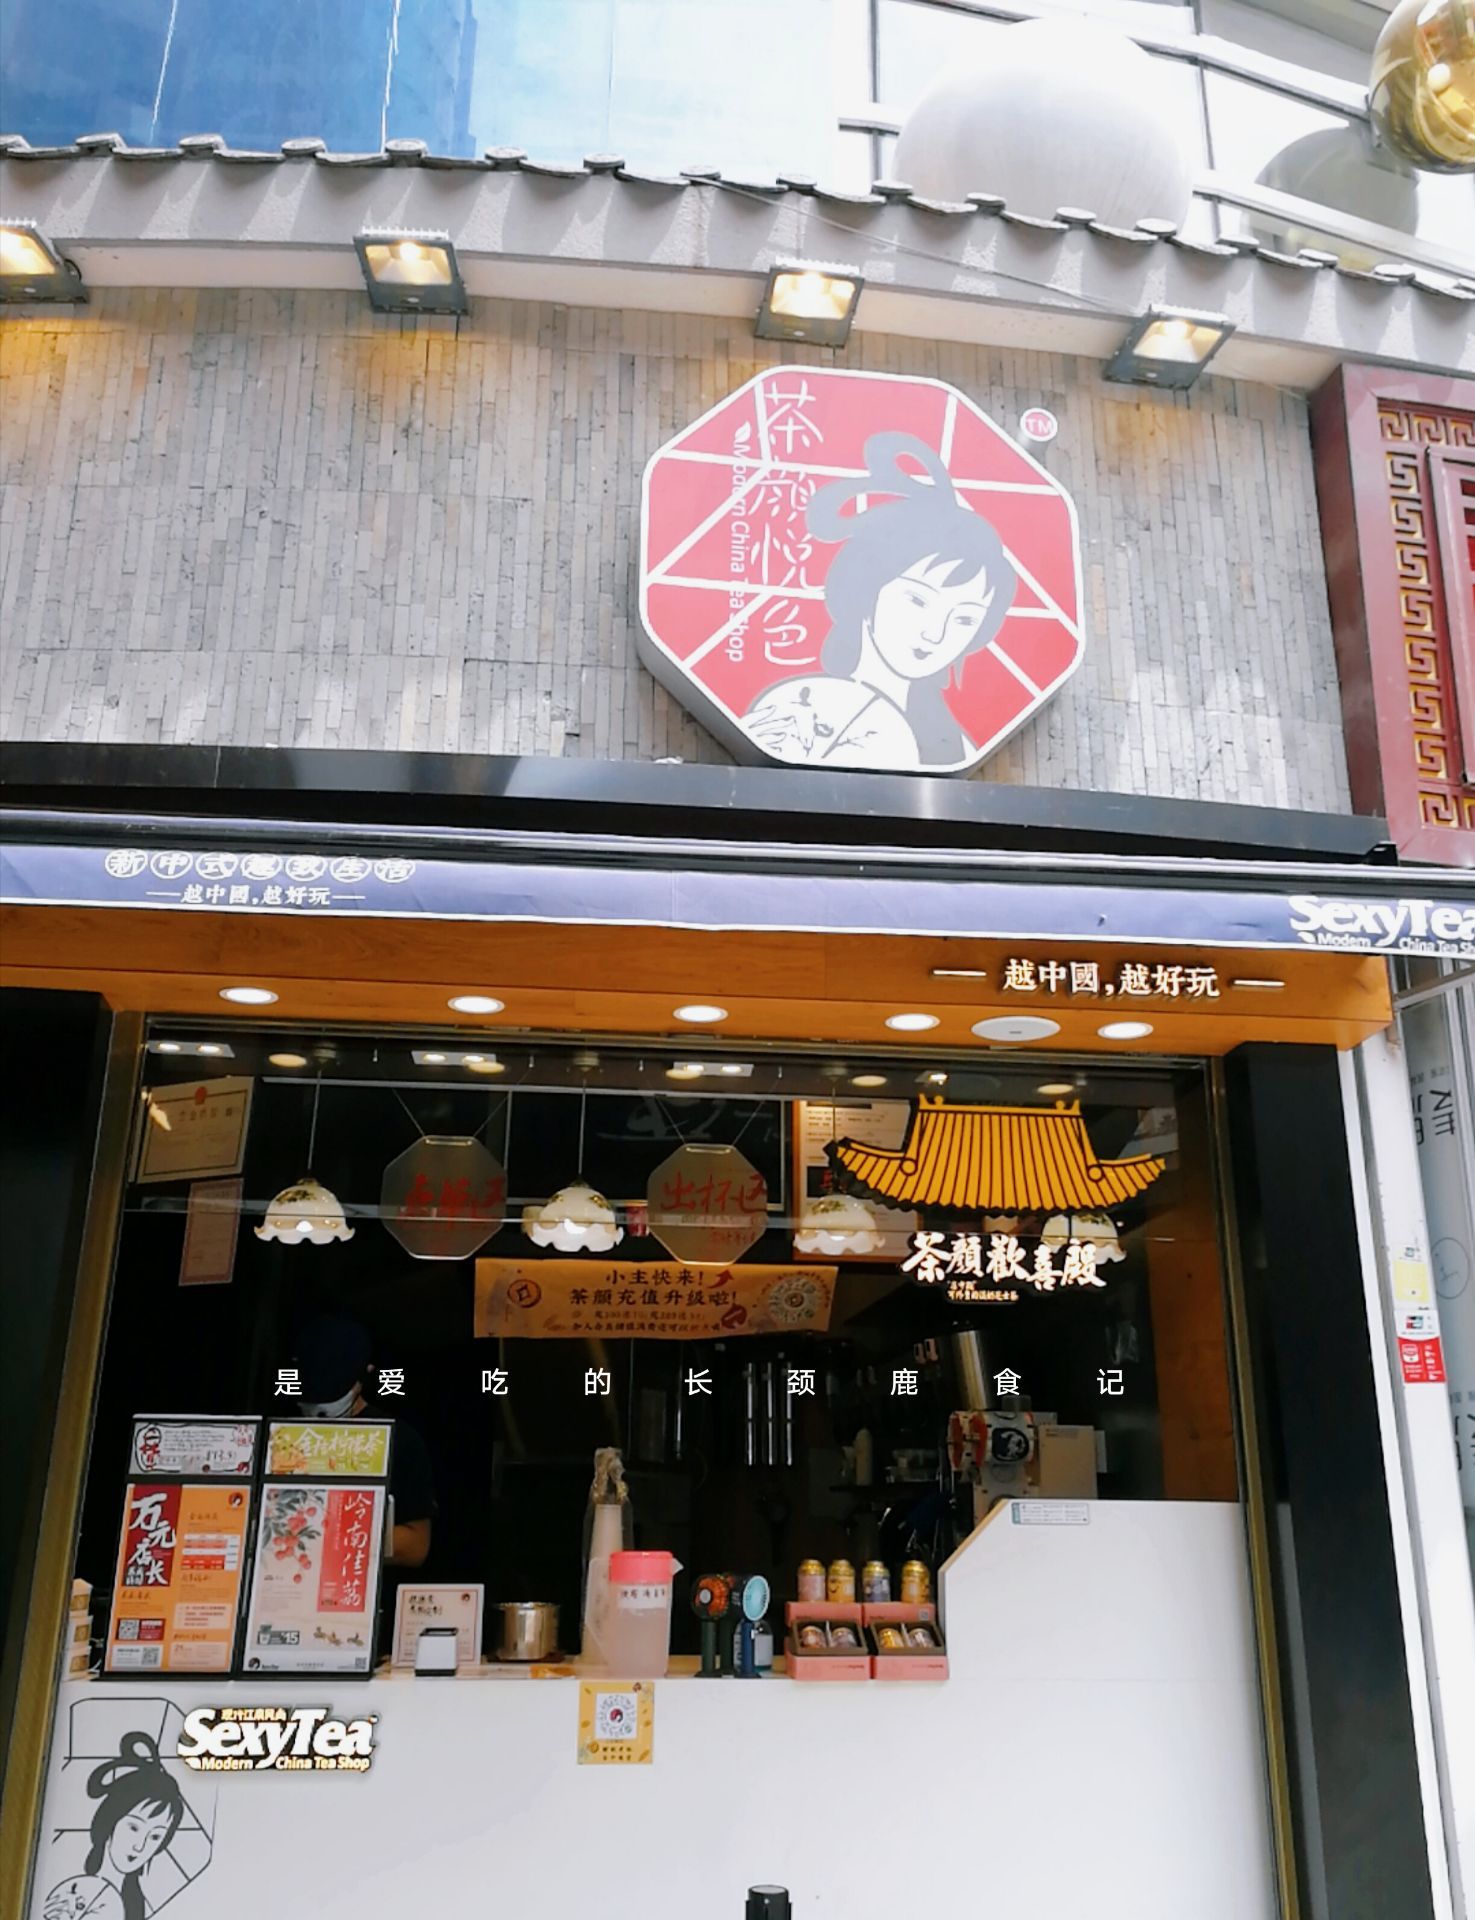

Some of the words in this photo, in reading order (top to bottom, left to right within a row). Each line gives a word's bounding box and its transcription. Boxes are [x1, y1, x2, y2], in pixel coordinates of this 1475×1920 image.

[1027, 418, 1051, 434] TM
[729, 519, 750, 573] China
[201, 1757, 253, 1770] Modern
[276, 1757, 312, 1770] China
[315, 1757, 337, 1770] Tea
[338, 1757, 371, 1773] Shop
